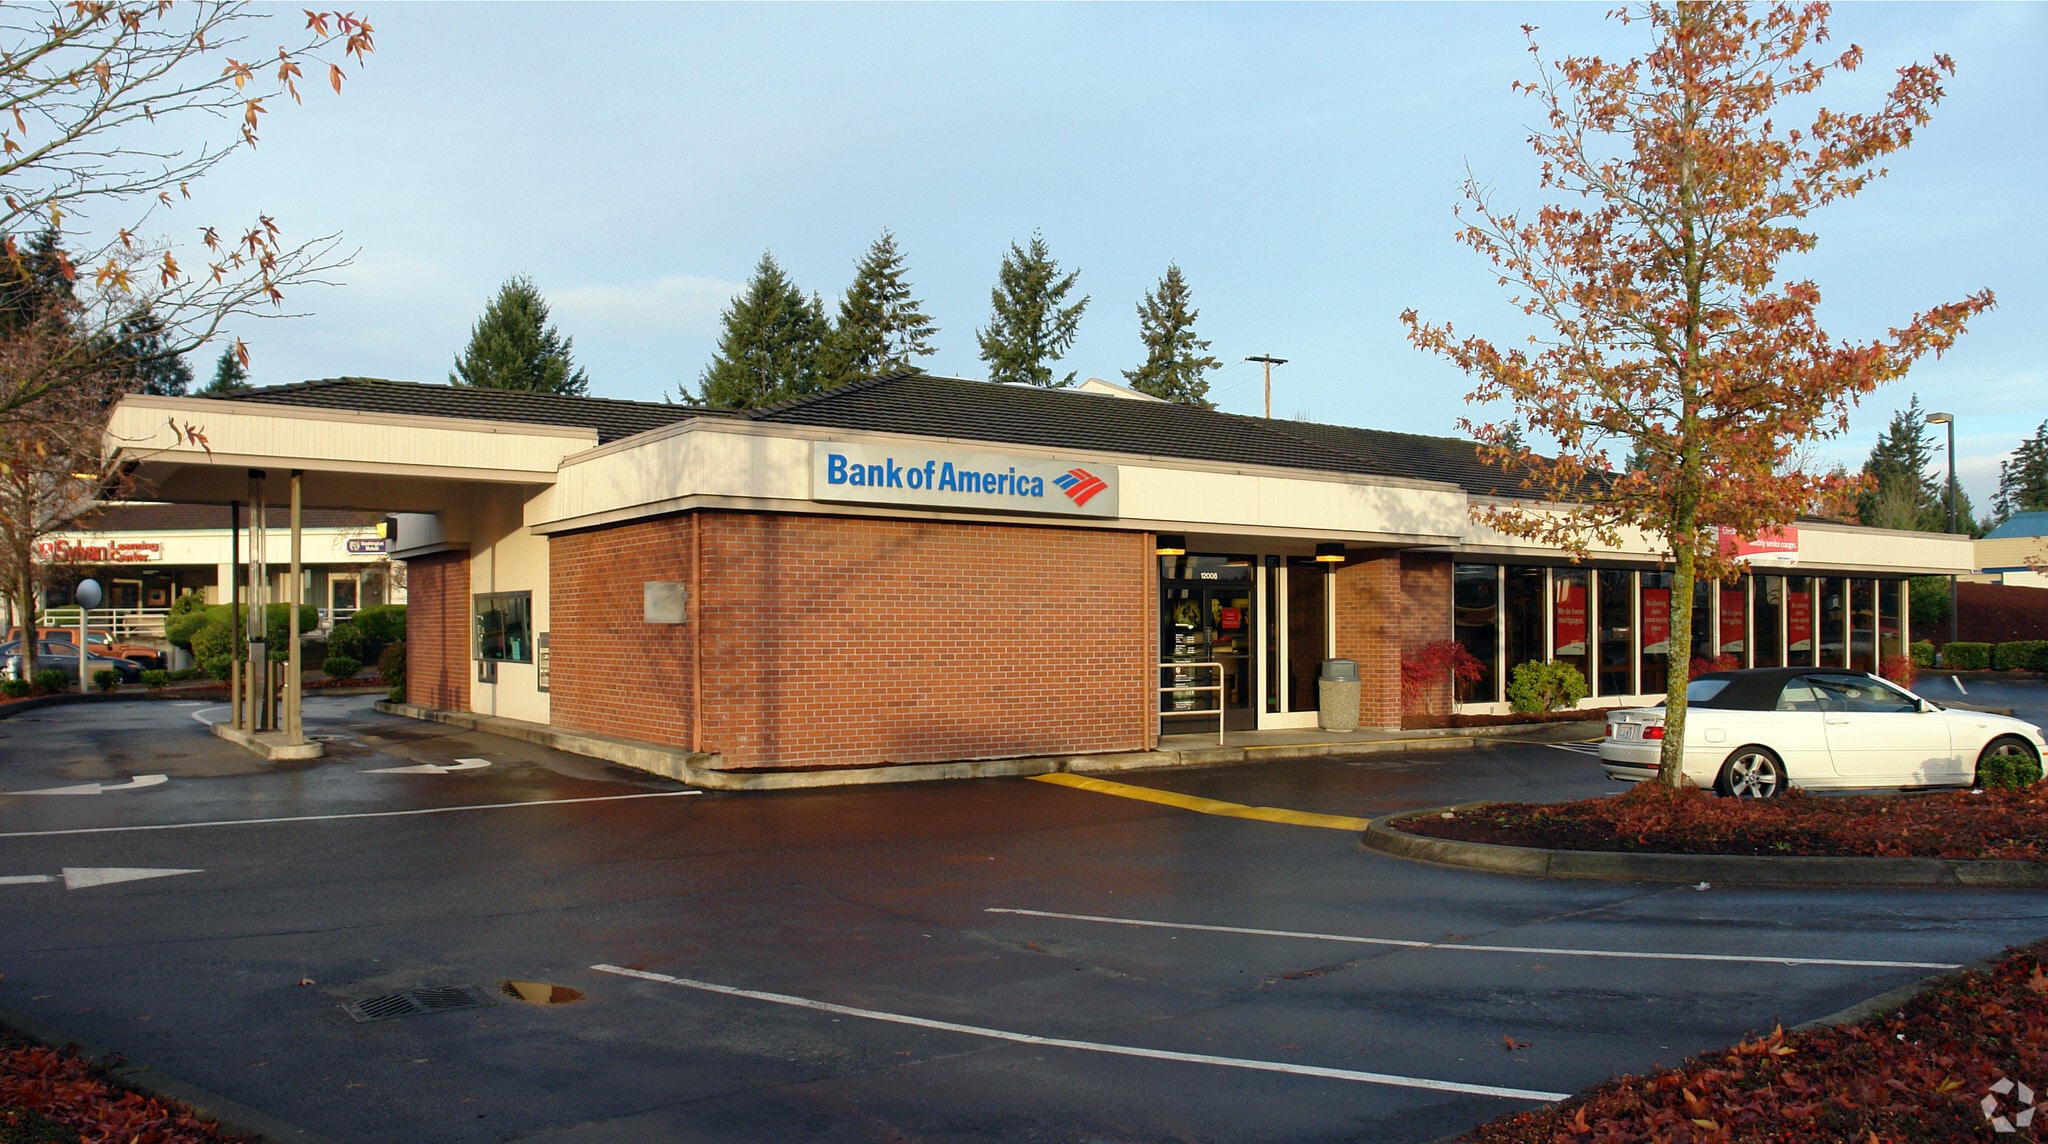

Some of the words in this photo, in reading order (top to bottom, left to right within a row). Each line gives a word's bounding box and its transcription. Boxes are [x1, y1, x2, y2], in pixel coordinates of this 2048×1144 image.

[827, 453, 903, 488] Bank
[906, 460, 936, 490] of
[938, 461, 1044, 497] America
[54, 539, 107, 564] Sylvan
[110, 541, 159, 552] Learning
[110, 551, 149, 561] Center
